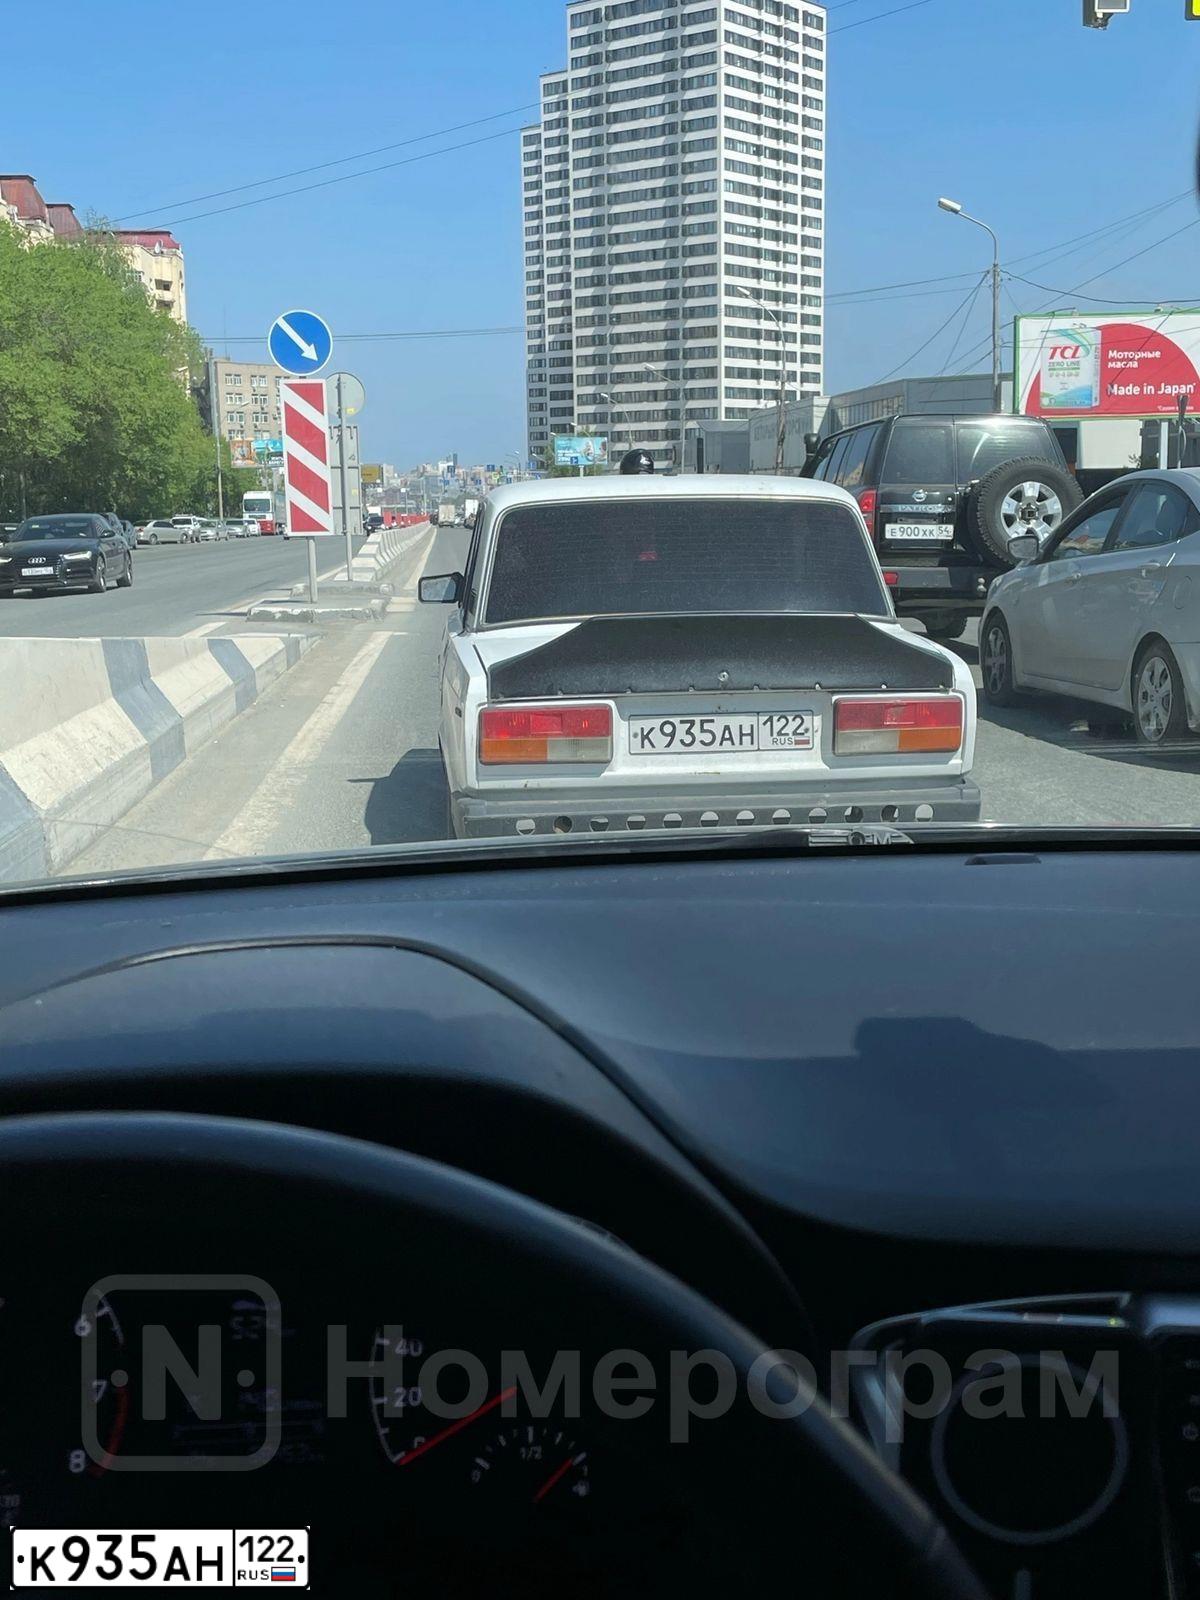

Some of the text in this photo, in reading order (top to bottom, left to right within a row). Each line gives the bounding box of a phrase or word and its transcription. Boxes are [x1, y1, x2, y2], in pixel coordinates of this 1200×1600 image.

[1049, 345, 1080, 360] TCL
[1108, 350, 1161, 360] Моторные
[1107, 360, 1139, 369] масла
[1107, 383, 1140, 396] Made
[1143, 383, 1155, 395] in
[762, 714, 805, 737] 122
[771, 736, 793, 746] RUS
[395, 1338, 424, 1358] 40
[91, 1378, 108, 1403] 7
[393, 1386, 423, 1408] 20
[68, 1449, 87, 1474] 8
